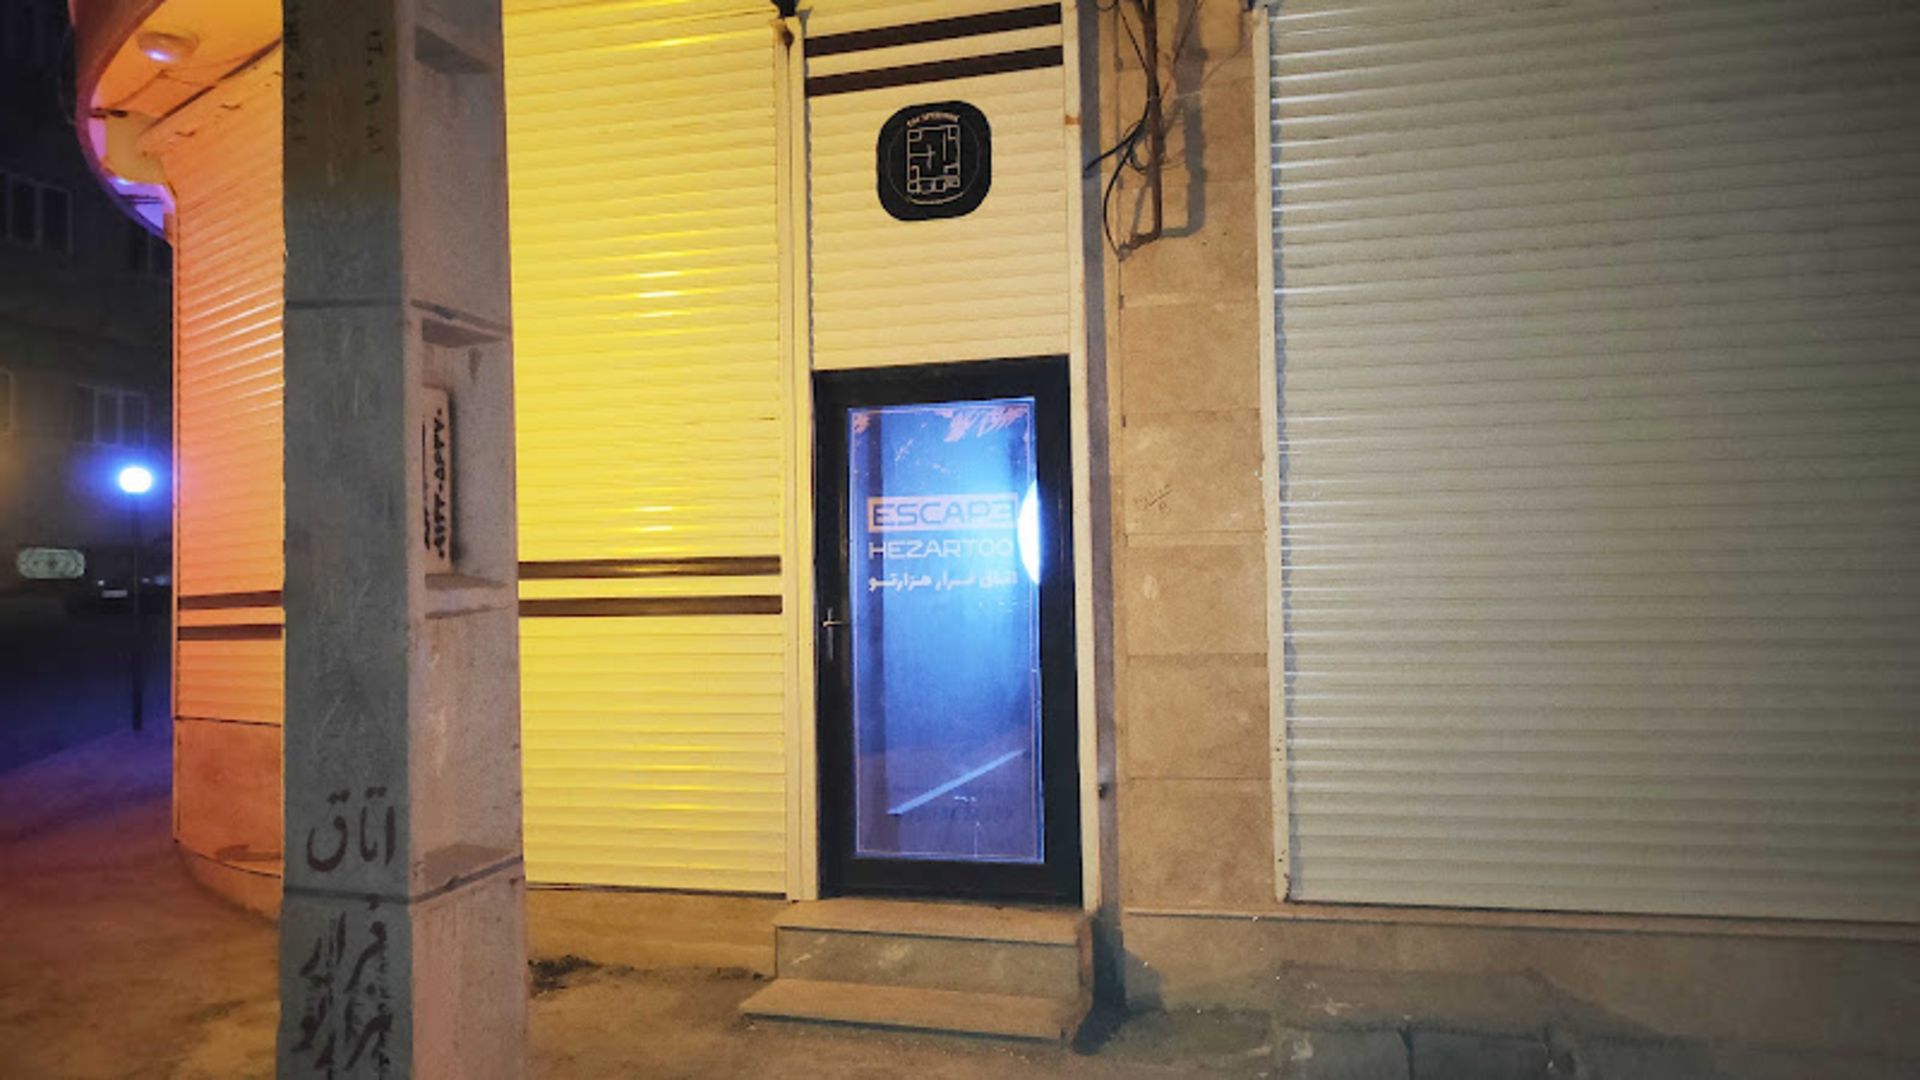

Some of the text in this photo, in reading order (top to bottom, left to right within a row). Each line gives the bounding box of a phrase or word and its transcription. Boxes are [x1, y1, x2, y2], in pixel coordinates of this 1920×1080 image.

[872, 499, 1012, 527] ESCAPE
[868, 537, 1013, 560] HEZARTOO
[868, 573, 932, 593] هزارتو
[306, 786, 396, 873] اتاق
